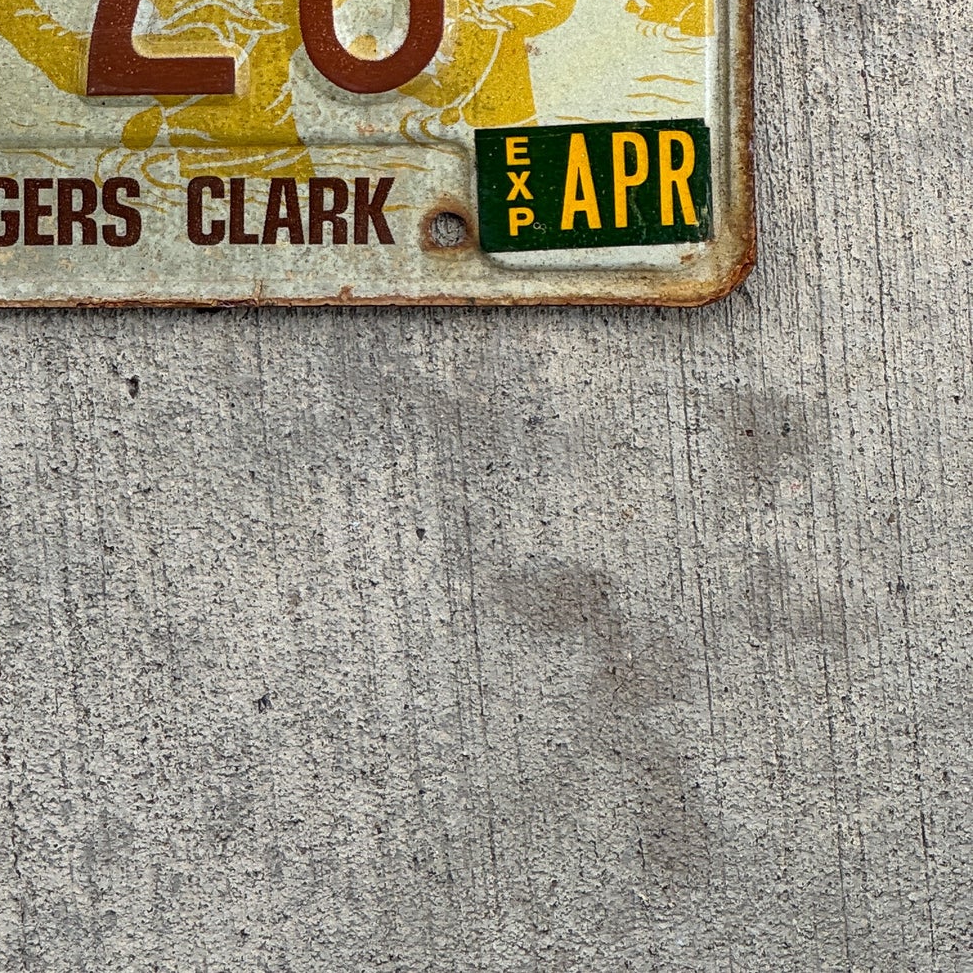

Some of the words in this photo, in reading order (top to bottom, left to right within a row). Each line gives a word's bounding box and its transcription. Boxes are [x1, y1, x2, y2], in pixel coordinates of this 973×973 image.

[186, 176, 395, 246] CLARK
[506, 137, 535, 236] EXP
[561, 130, 699, 230] APR
